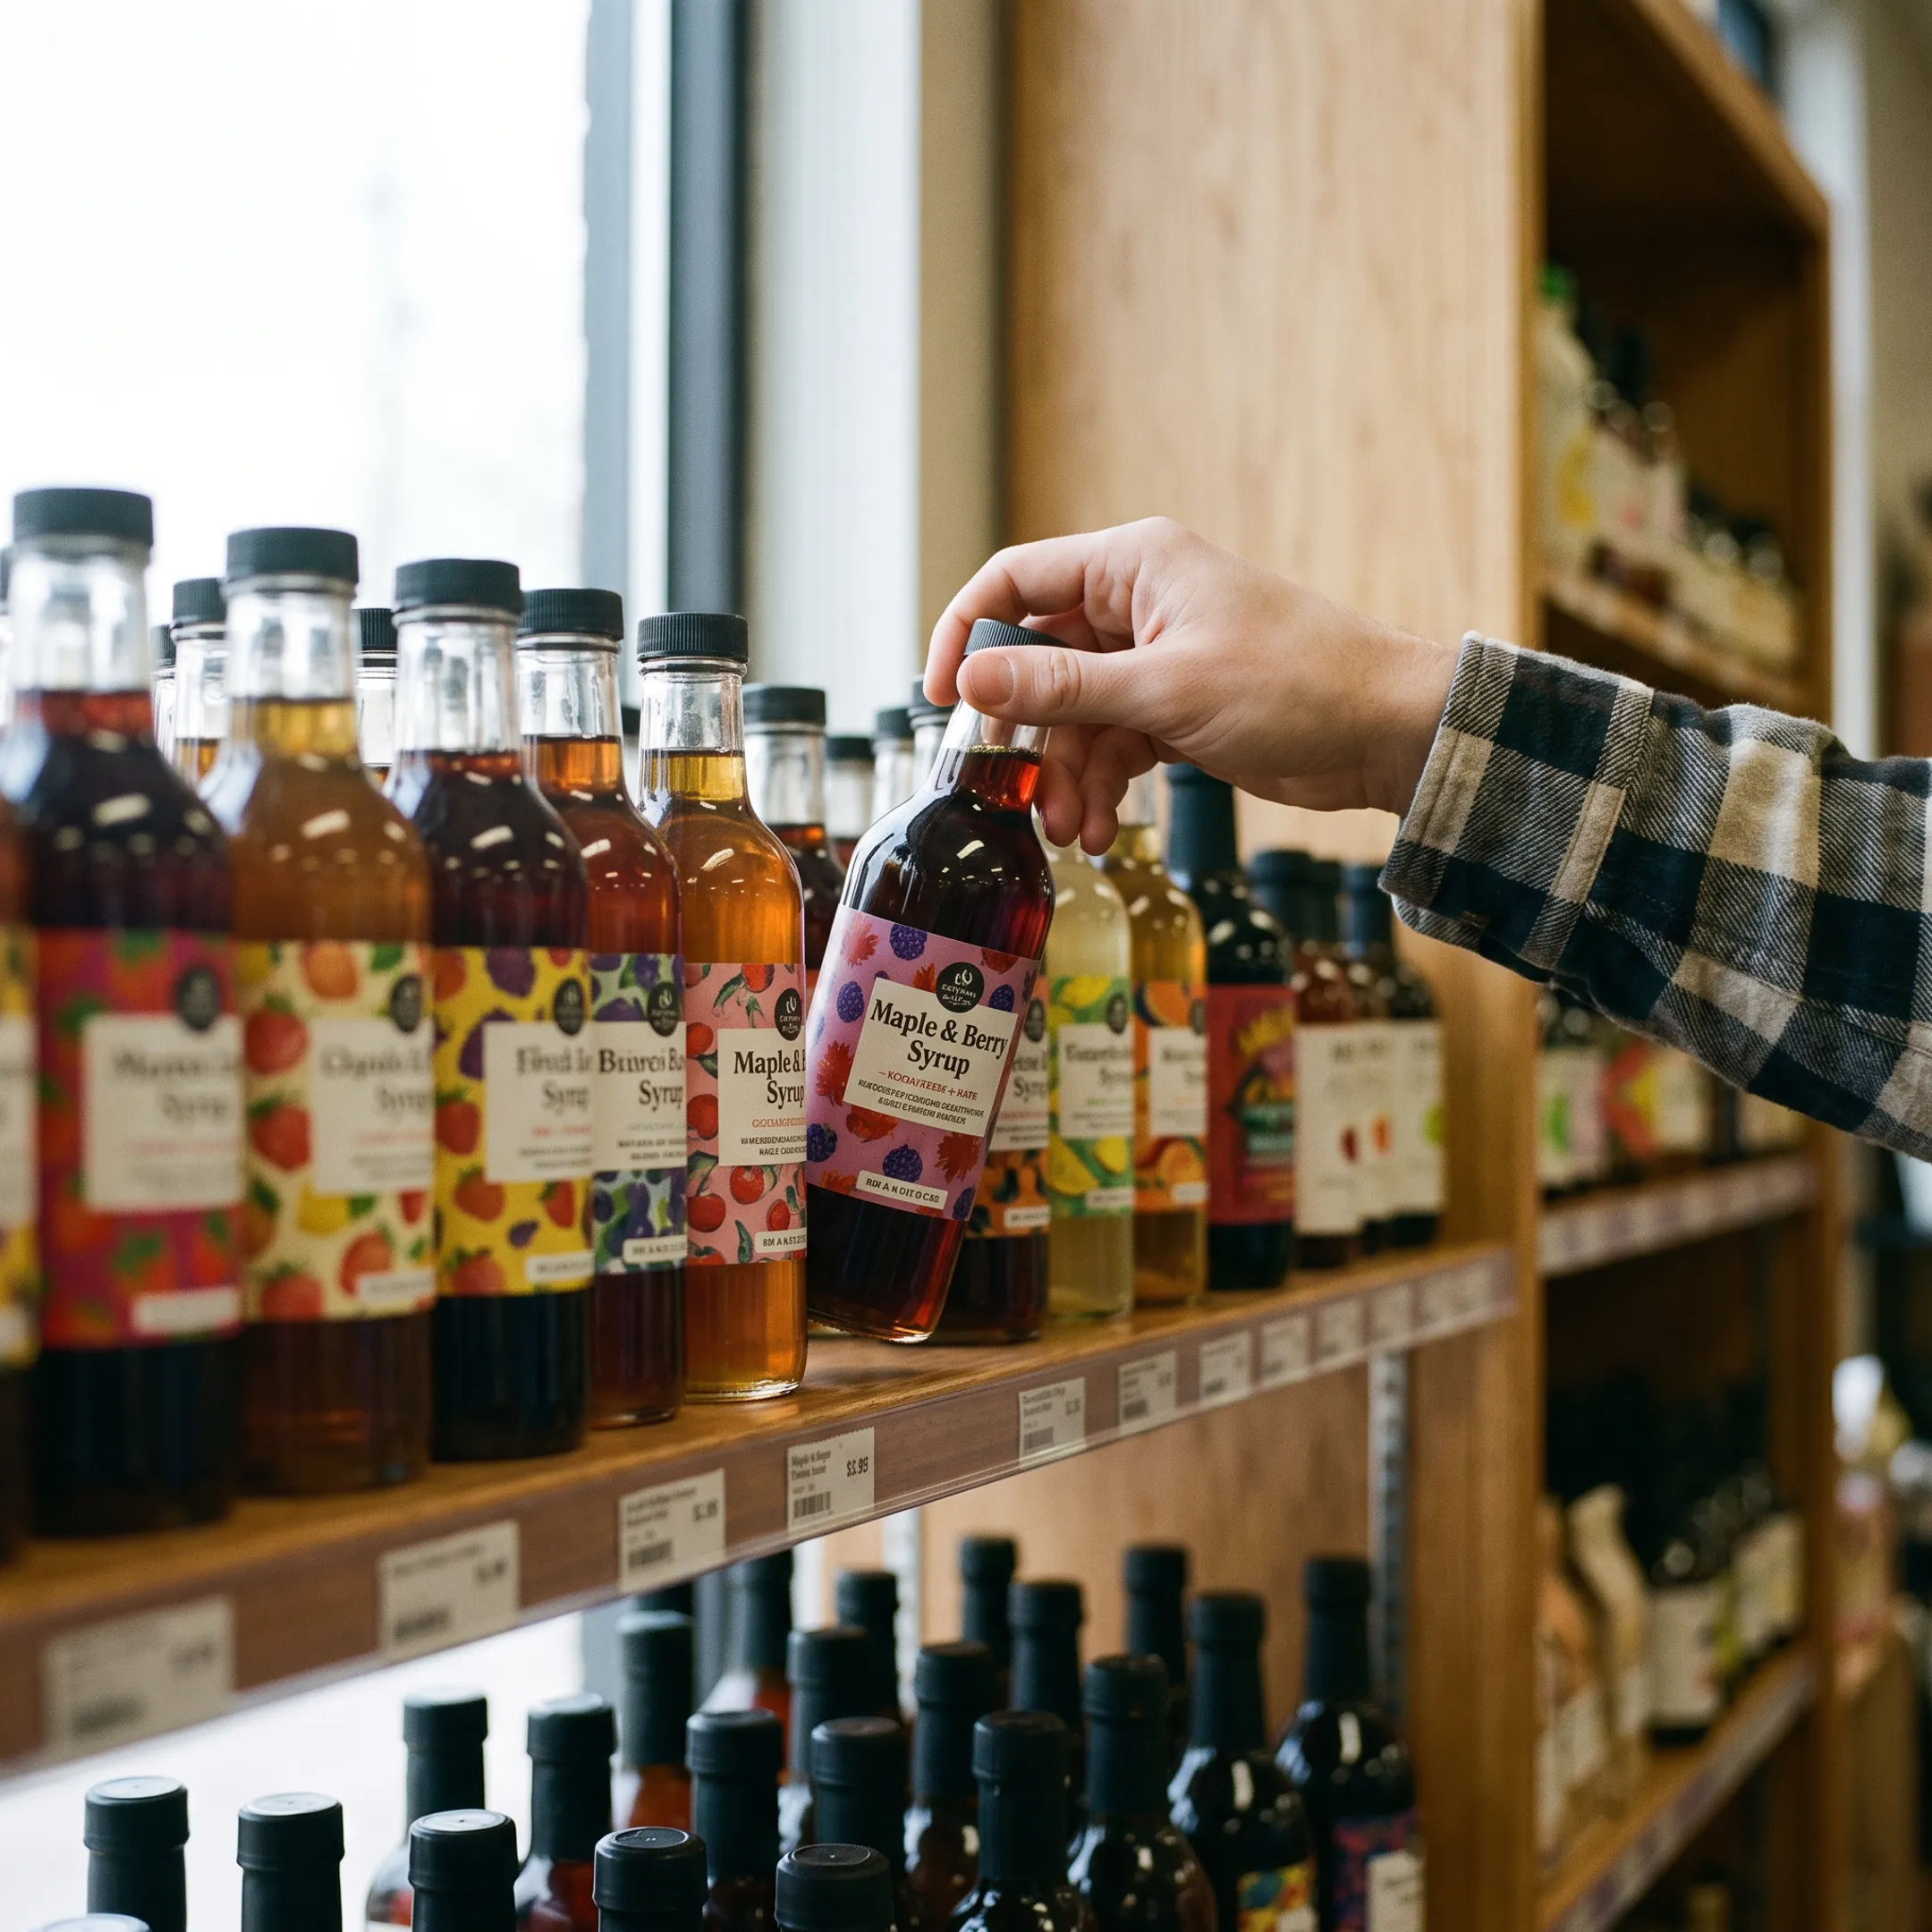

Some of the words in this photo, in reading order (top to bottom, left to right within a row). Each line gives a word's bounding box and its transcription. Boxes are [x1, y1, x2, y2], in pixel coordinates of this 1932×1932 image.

[870, 999, 937, 1037] Maple
[940, 1019, 958, 1043] &
[961, 1024, 1008, 1060] Berry
[733, 1049, 791, 1080] Maple
[792, 1049, 801, 1072] &
[907, 1039, 970, 1080] Syrup
[767, 1080, 804, 1110] Syrup
